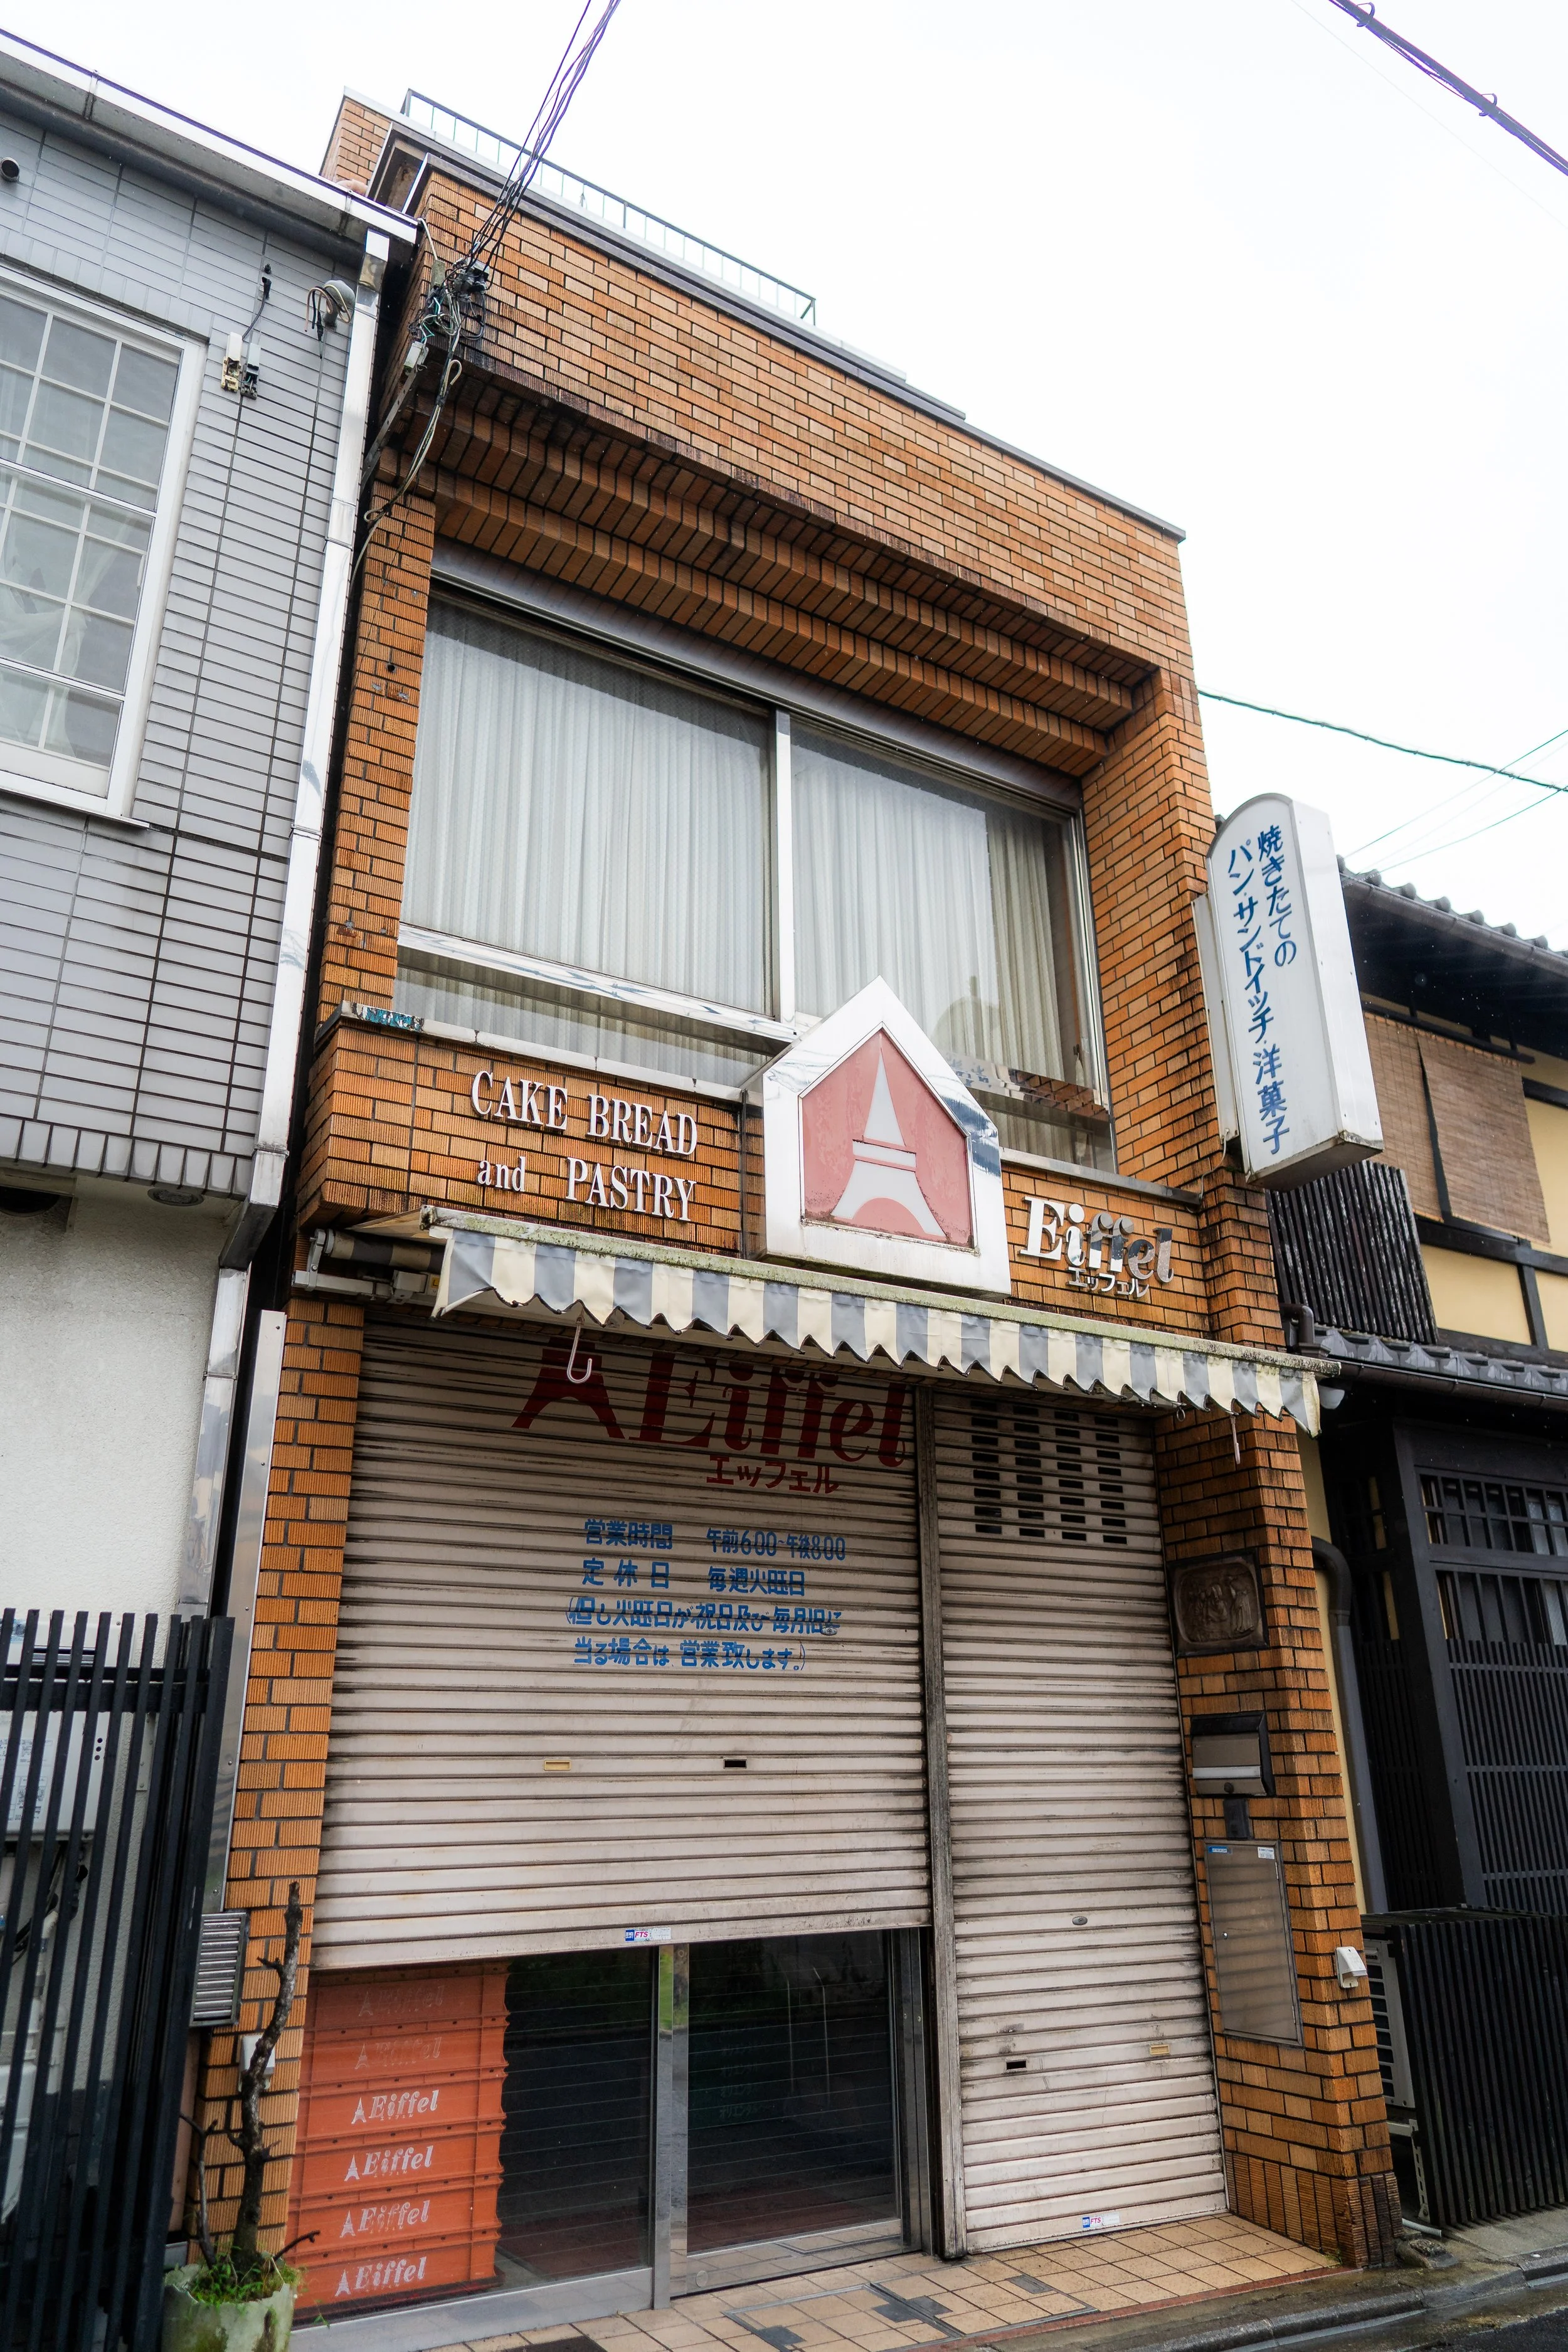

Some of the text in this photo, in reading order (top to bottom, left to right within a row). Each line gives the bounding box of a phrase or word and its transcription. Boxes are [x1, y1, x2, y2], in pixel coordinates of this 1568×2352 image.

[1258, 825, 1296, 967] 焼きたての
[471, 1071, 698, 1155] CAKE BREAD
[477, 1157, 697, 1222] and PASTRY
[1019, 1196, 1174, 1284] Eiffel
[1066, 1266, 1150, 1298] エッフェル
[628, 1351, 906, 1467] Eiffel
[706, 1454, 840, 1494] エッフェル
[584, 1518, 673, 1550] 営業時間
[582, 1557, 669, 1589] 定休日
[368, 2089, 439, 2119] Eiffel
[362, 2145, 433, 2175] Eiffel
[358, 2200, 430, 2232] Eiffel
[354, 2256, 426, 2290] Eiffel
